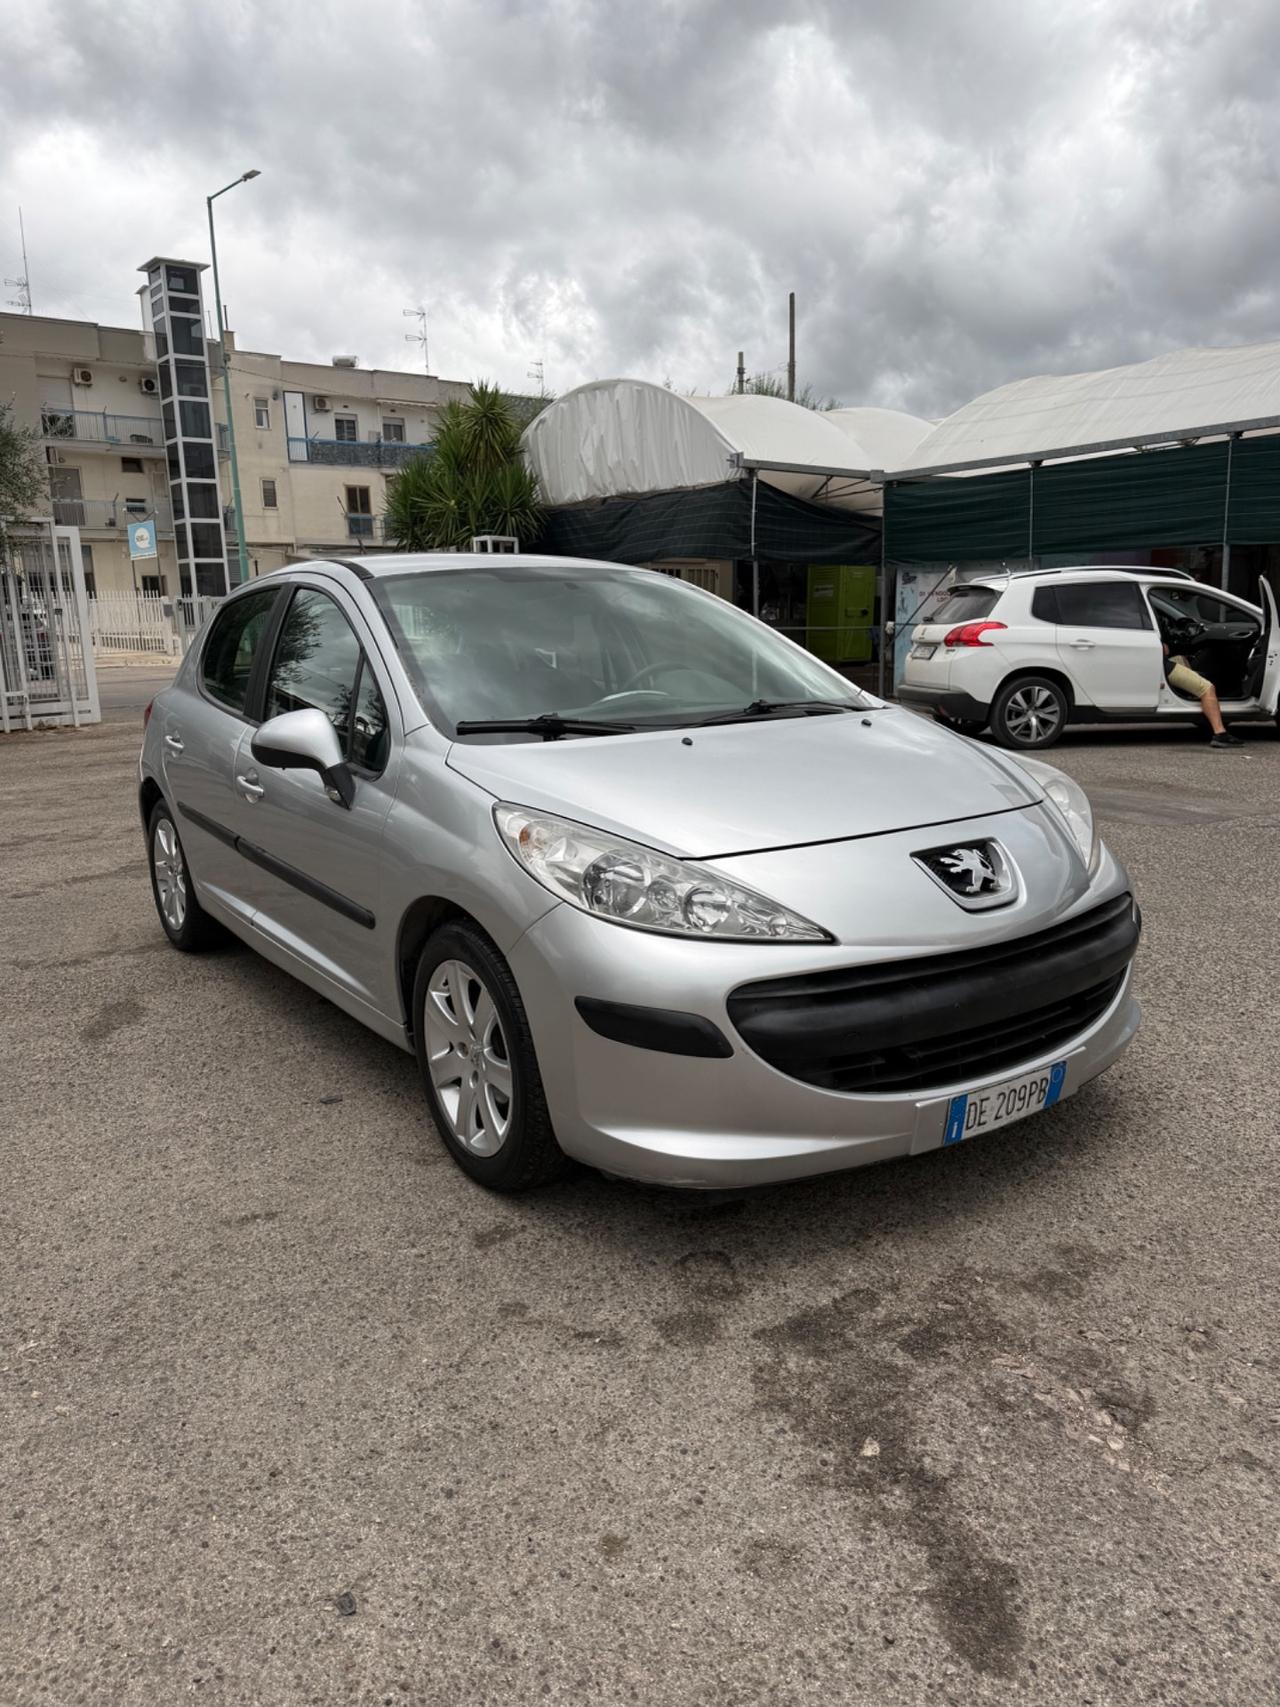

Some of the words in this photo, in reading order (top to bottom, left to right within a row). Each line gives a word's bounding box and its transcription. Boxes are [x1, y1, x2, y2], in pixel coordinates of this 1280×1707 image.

[965, 1097, 991, 1131] DE
[994, 1077, 1049, 1121] 209PB
[952, 1122, 958, 1138] I
